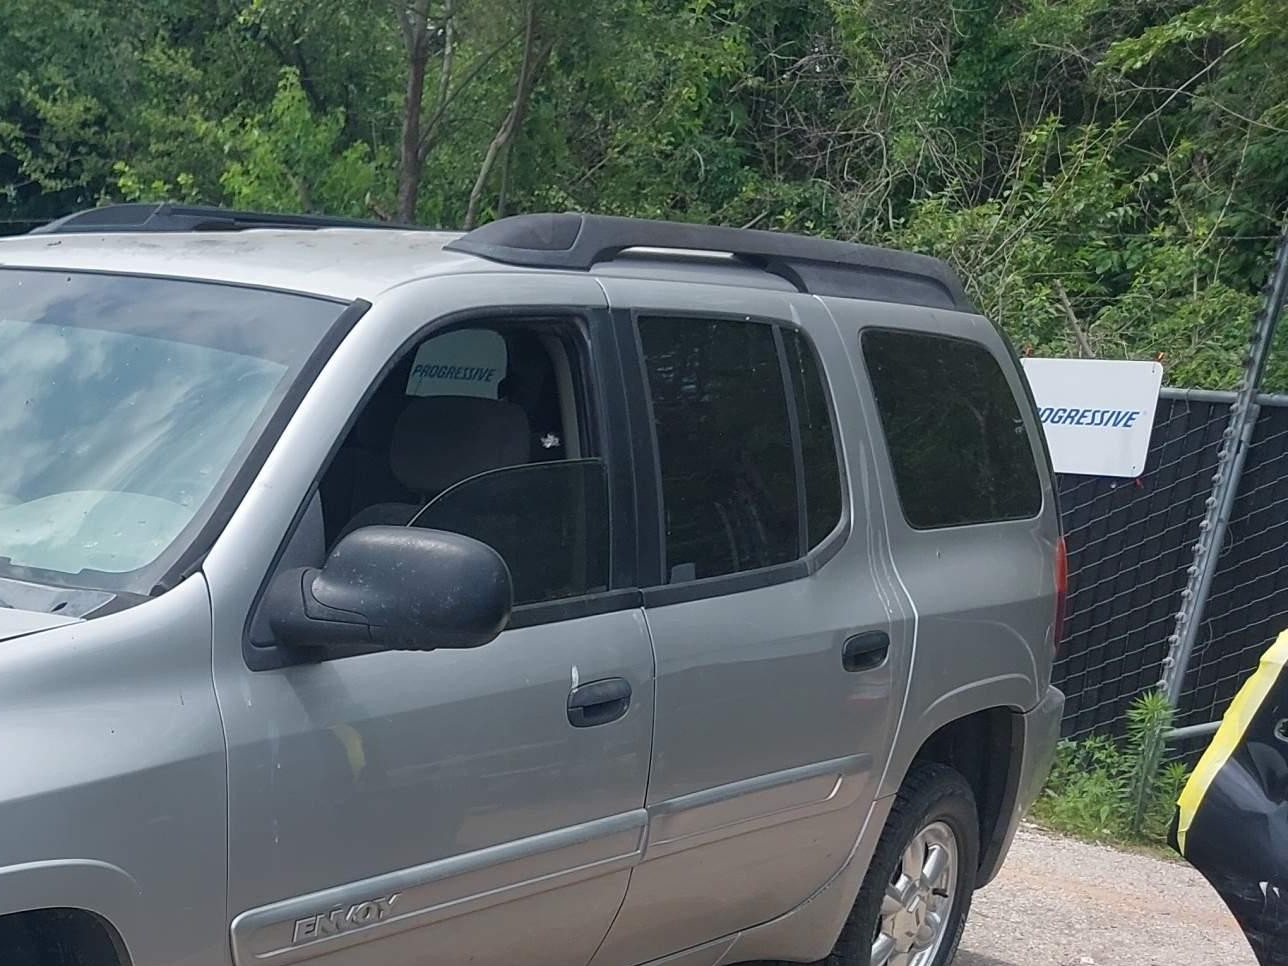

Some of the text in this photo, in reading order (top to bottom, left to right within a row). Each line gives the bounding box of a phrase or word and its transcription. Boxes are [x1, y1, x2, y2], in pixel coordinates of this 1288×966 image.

[411, 364, 497, 383] PROGRESSIVE
[1037, 407, 1140, 428] OGRESSIVE
[291, 893, 402, 944] ENVOY
